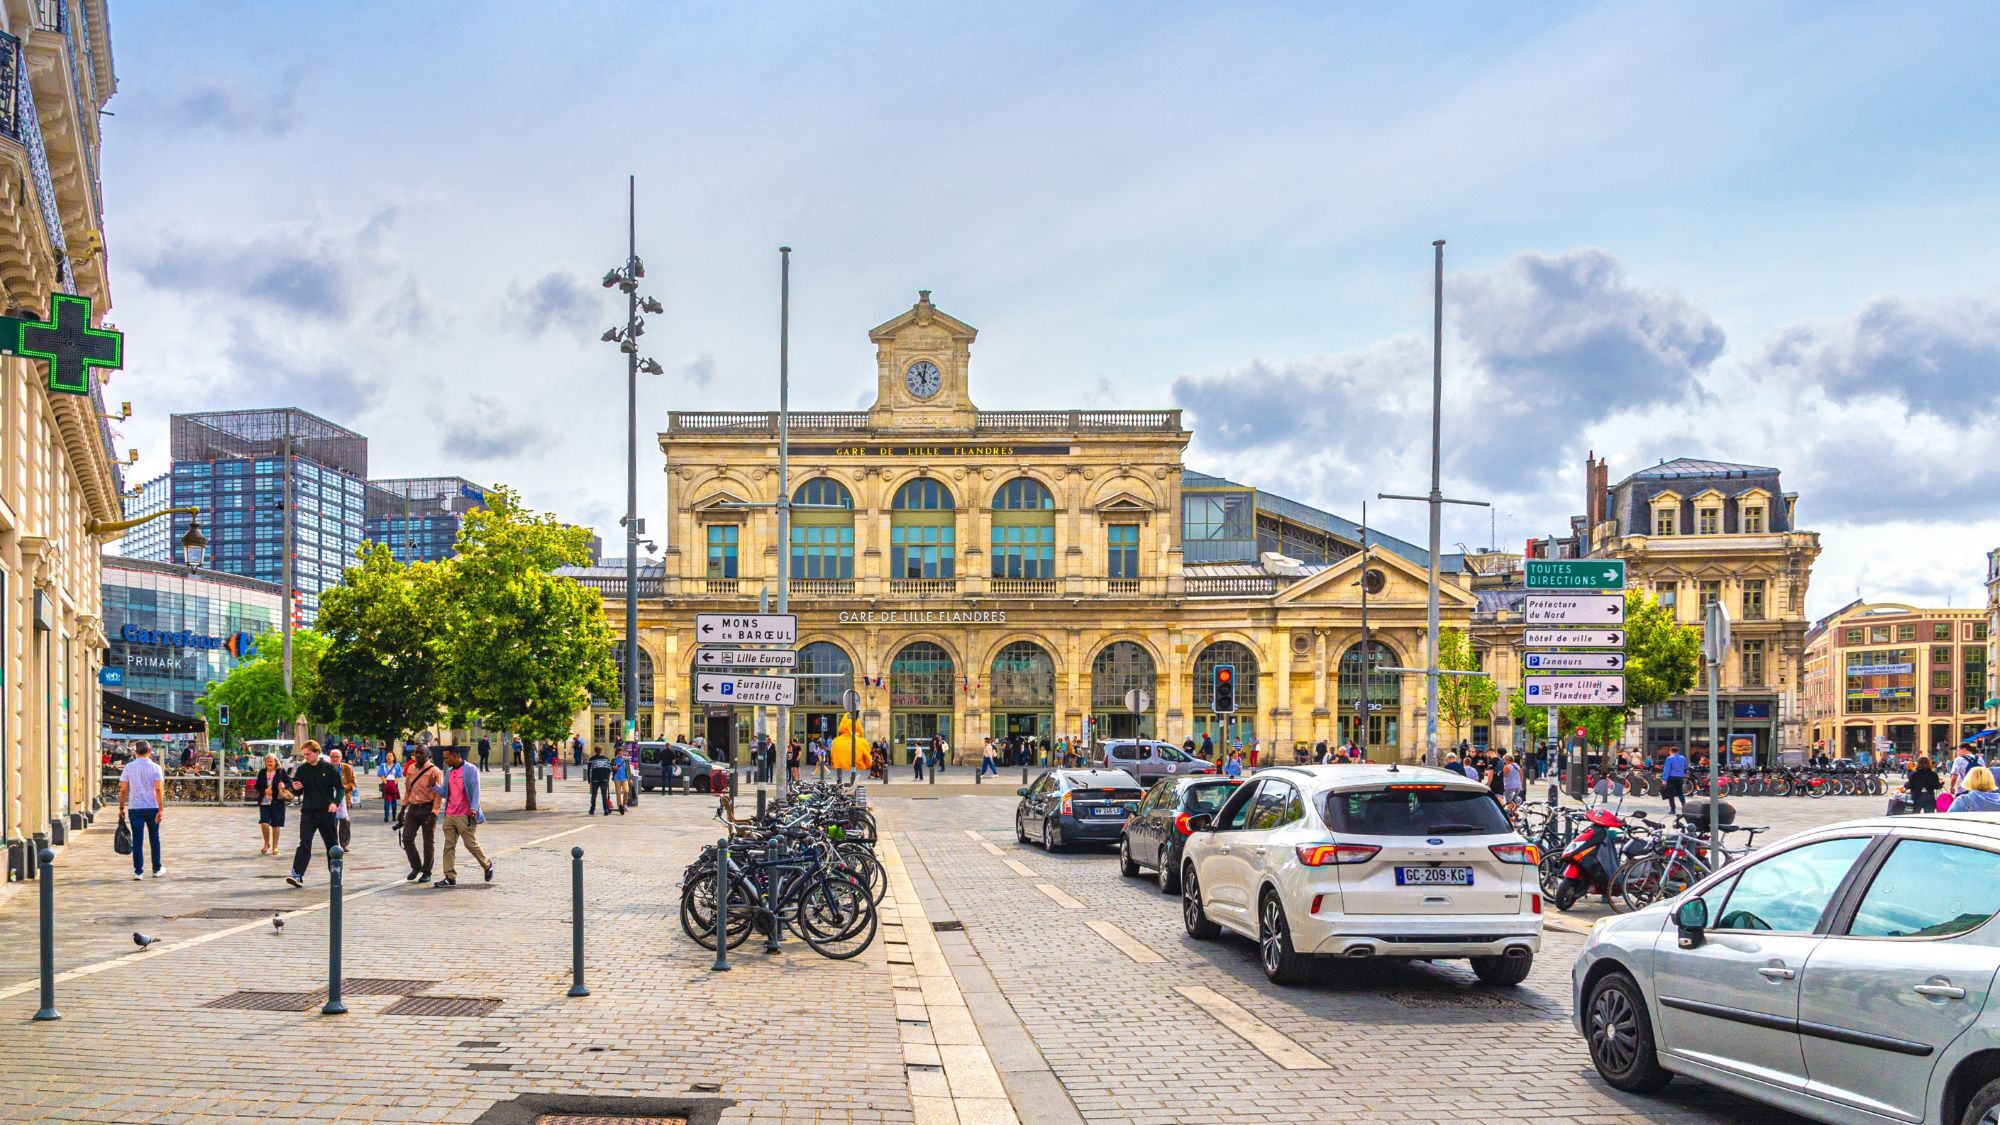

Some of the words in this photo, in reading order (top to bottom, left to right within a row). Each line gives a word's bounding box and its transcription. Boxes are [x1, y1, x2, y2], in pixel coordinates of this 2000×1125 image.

[836, 447, 866, 456] GARE
[880, 447, 894, 456] DE
[908, 447, 940, 456] LILLE
[954, 447, 1013, 455] FLANDRES
[1530, 564, 1572, 574] TOUTES
[1530, 576, 1597, 585] DIRECTIONS
[1529, 600, 1577, 608] Préfecture
[839, 611, 874, 621] GARE
[881, 611, 897, 621] DE
[903, 611, 933, 621] LILLE
[939, 611, 1006, 622] FLANDRES
[722, 619, 758, 628] MONS
[122, 624, 222, 650] Carrefour
[738, 631, 792, 640] BARŒUL
[1529, 634, 1552, 642] hôtel
[1556, 634, 1567, 642] de
[1572, 634, 1593, 642] ville
[127, 655, 182, 669] PRIMARK
[736, 654, 757, 663] Lille
[759, 654, 792, 665] Europe
[1542, 657, 1582, 665] Tanneurs
[736, 679, 782, 689] Euralille
[1553, 682, 1573, 690] gare
[1577, 680, 1597, 688] Lille
[736, 692, 770, 701] centre
[1553, 691, 1592, 699] Flandres
[1354, 701, 1382, 710] fac
[1406, 869, 1465, 881] GC-209-KG
